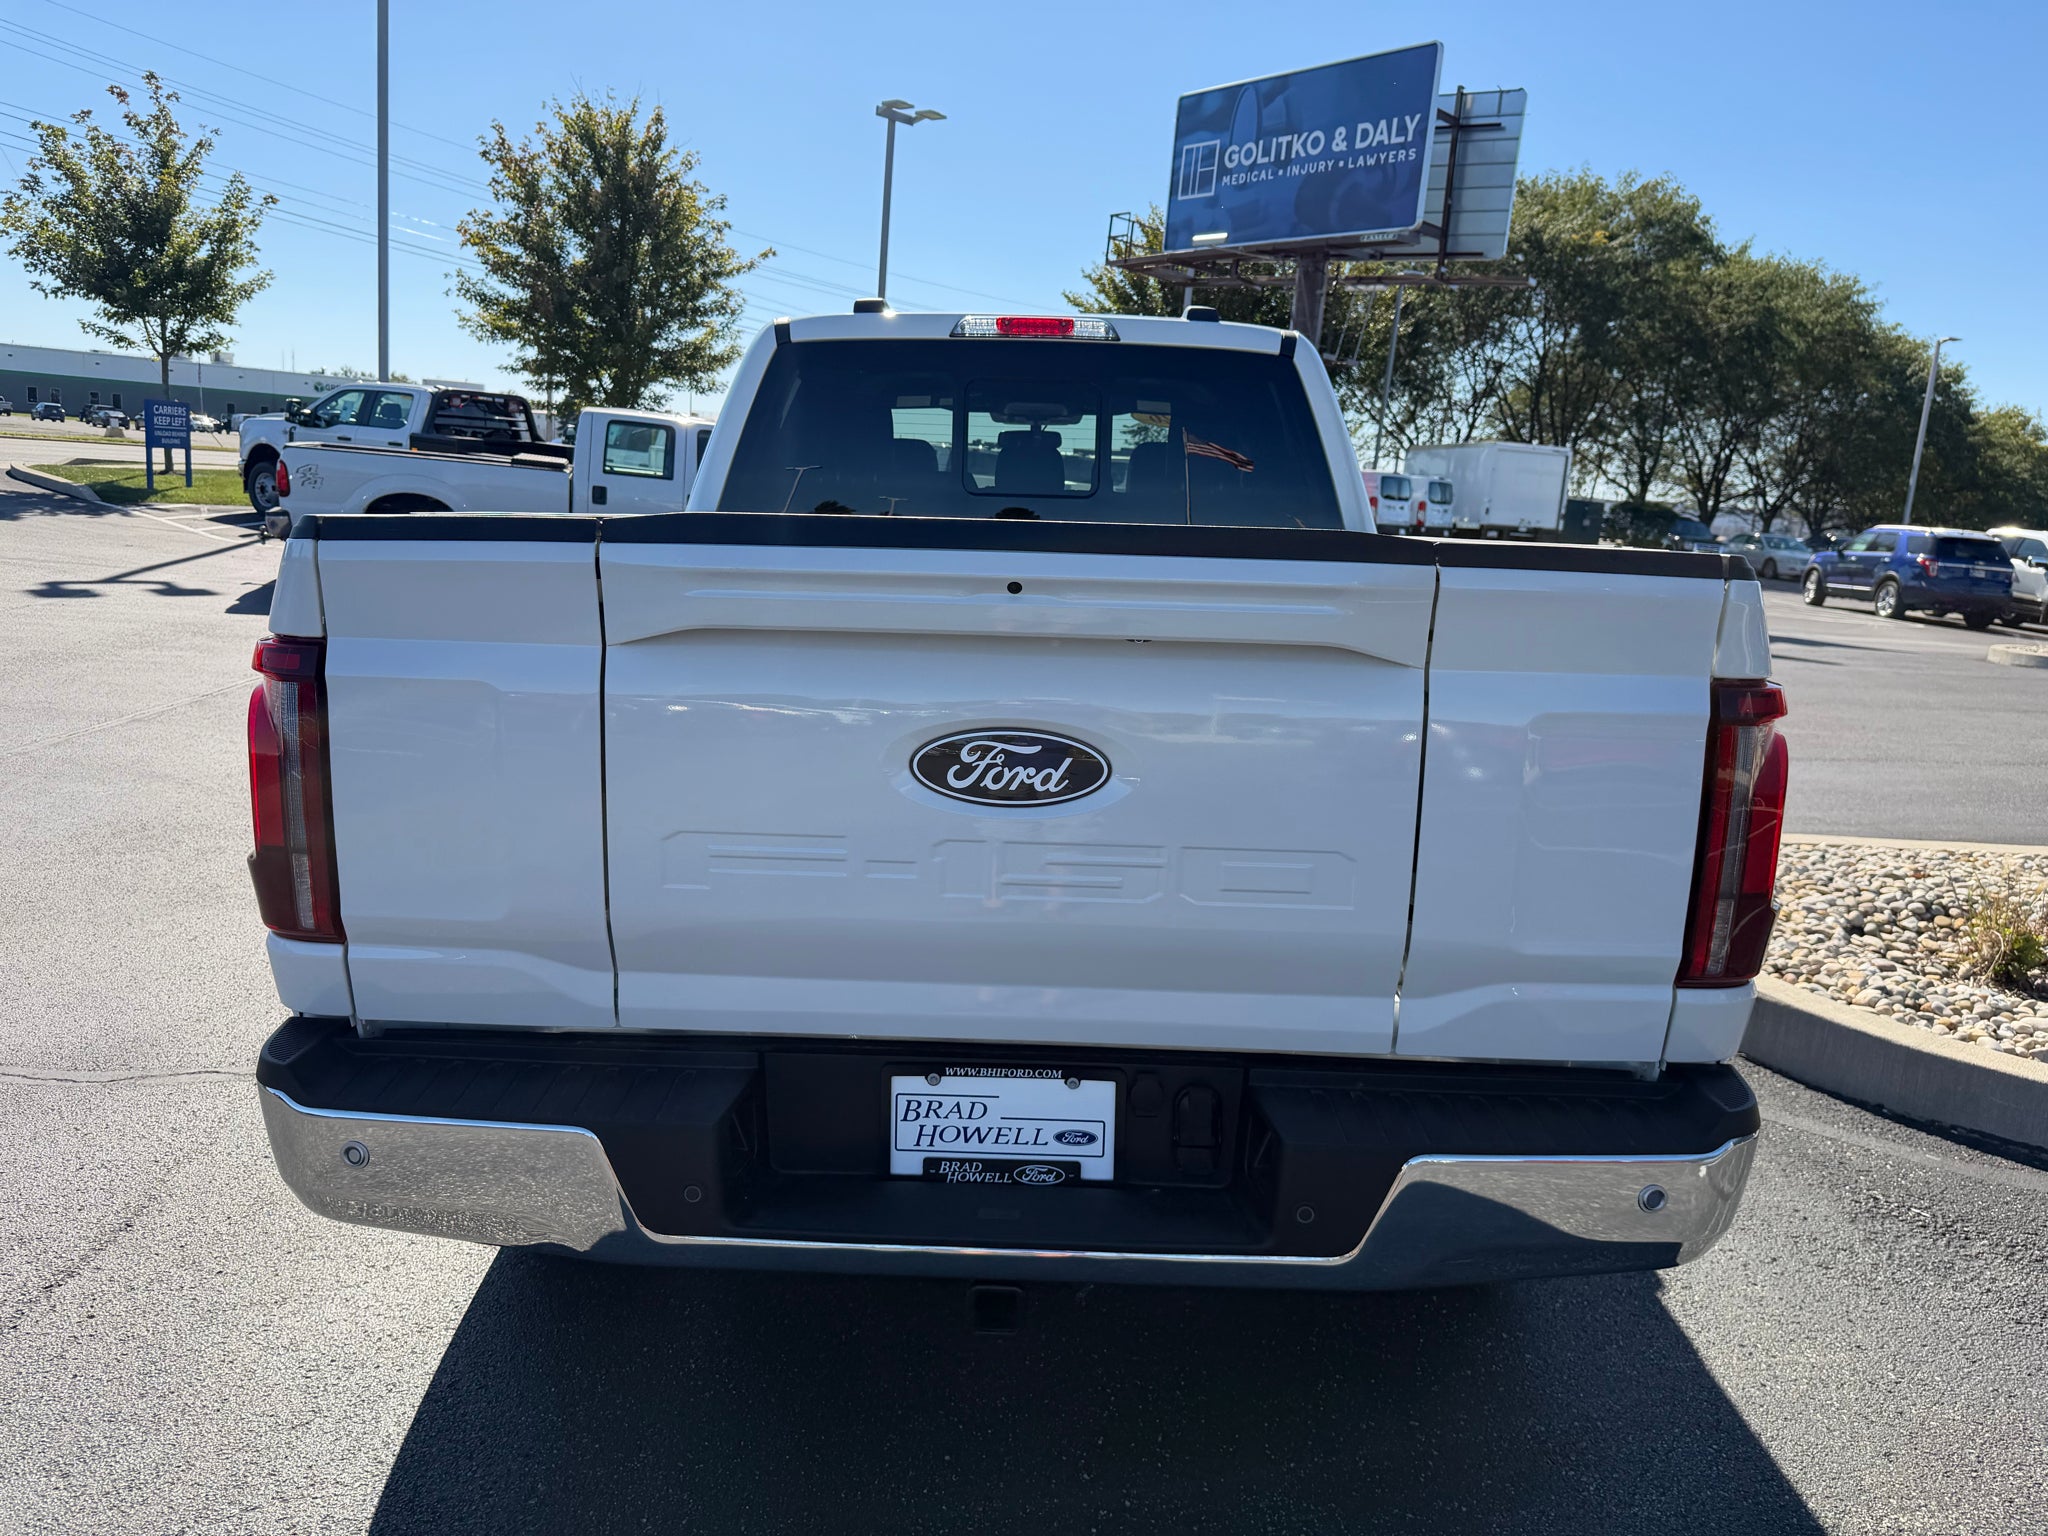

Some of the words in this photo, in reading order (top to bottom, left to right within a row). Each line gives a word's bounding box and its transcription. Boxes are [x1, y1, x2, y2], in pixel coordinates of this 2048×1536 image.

[1224, 131, 1325, 168] GOLITKO
[1332, 126, 1348, 152] &
[1355, 113, 1421, 149] DALY
[1221, 169, 1275, 187] MEDICAL
[1286, 159, 1336, 178] INJURY
[1348, 147, 1417, 169] LAWYERS
[153, 405, 187, 416] CARRIERS
[153, 416, 171, 425] KEEP
[171, 417, 186, 426] LEFT
[946, 739, 1070, 793] Ford
[660, 829, 1357, 911] F-150
[945, 1067, 1062, 1079] WWW.BHIFORD.COM
[901, 1099, 988, 1122] BRAD
[913, 1124, 1049, 1147] HOWELL
[939, 1161, 982, 1174] BRAD
[946, 1172, 1012, 1183] HOWELL
[1021, 1167, 1057, 1182] Ford
